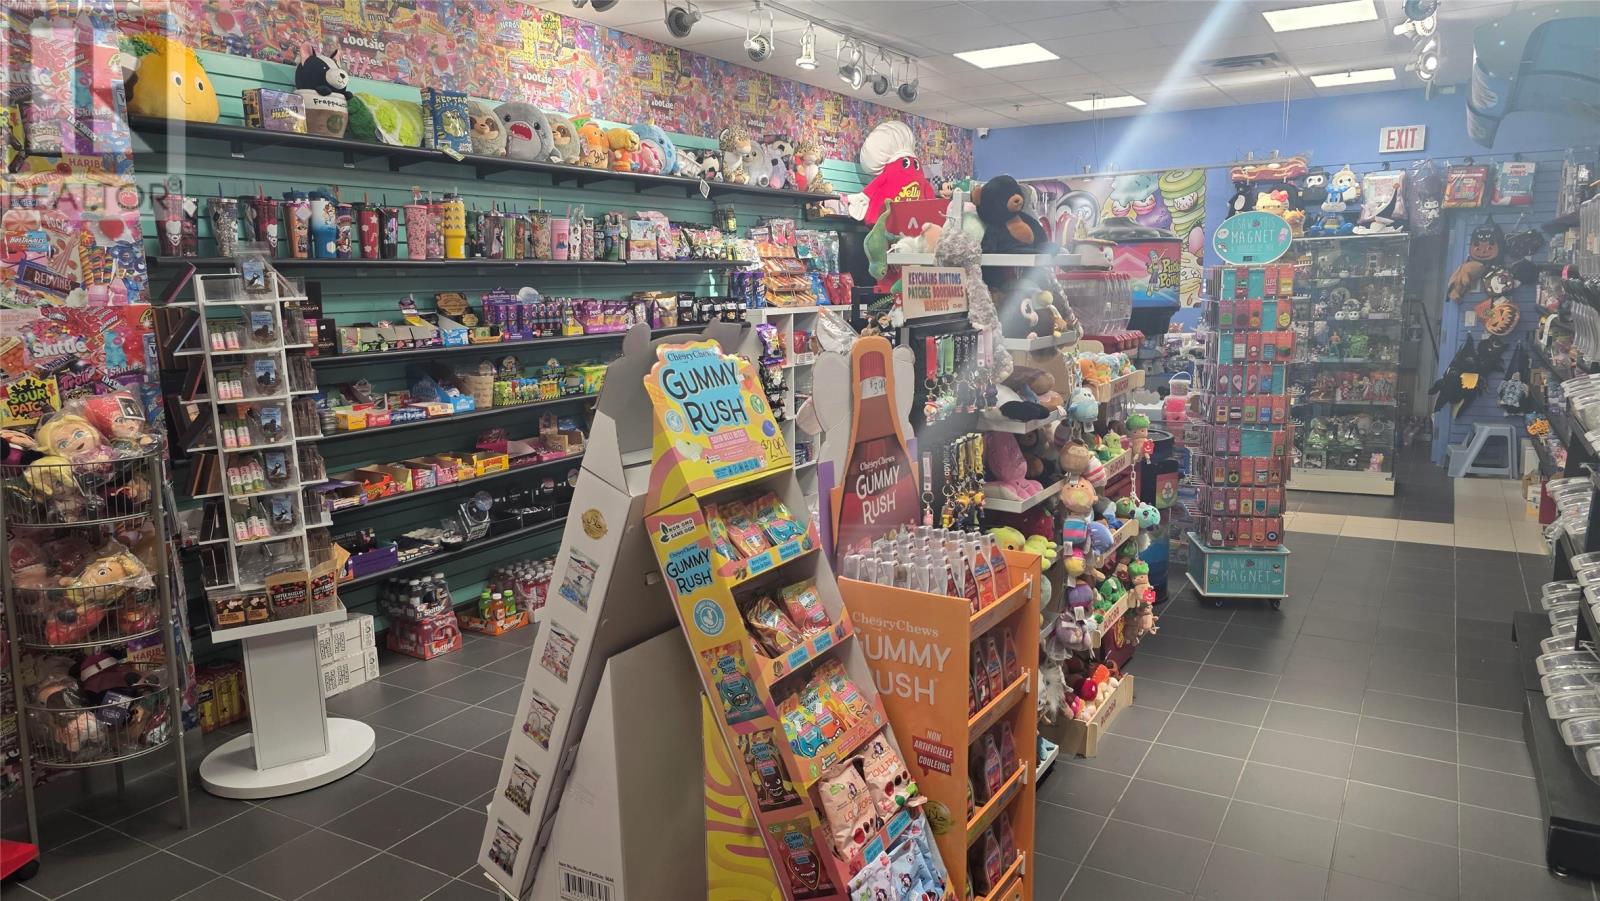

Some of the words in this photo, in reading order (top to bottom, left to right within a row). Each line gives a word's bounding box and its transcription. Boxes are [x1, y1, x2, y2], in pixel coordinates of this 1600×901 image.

[1386, 127, 1418, 150] EXIT
[1231, 229, 1275, 244] MAGNET
[908, 272, 938, 285] KEYCHAINS
[908, 286, 931, 299] PATCHES
[662, 361, 739, 400] GUMMY
[9, 387, 48, 404] SOUR
[683, 397, 748, 433] RUSH
[855, 465, 901, 500] GUMMY
[862, 491, 897, 525] RUSH
[665, 547, 710, 579] GUMMY
[675, 569, 713, 594] RUSH
[1220, 569, 1271, 584] MAGNET
[854, 630, 951, 673] UMMY
[927, 730, 942, 742] NON
[914, 739, 953, 760] ARTIFICIELLE
[918, 755, 951, 774] COULEURS
